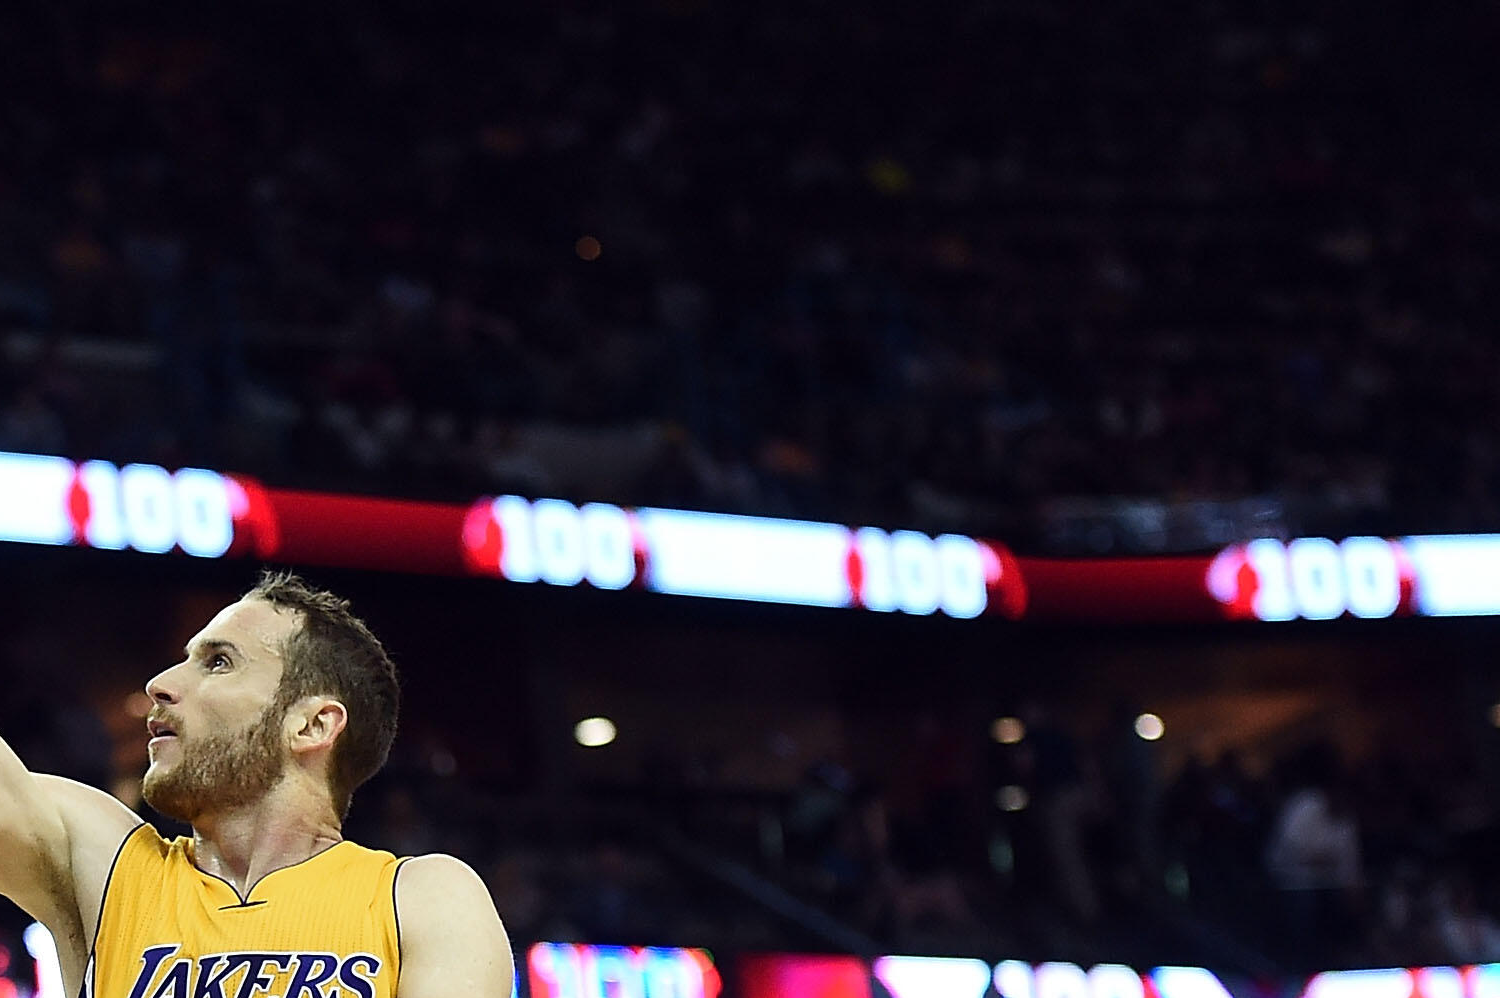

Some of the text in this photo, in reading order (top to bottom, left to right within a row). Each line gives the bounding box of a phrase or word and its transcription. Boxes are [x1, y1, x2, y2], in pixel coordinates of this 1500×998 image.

[77, 459, 235, 559] 100
[493, 494, 636, 590] 100
[858, 526, 988, 619] 100
[1246, 536, 1400, 622] 100
